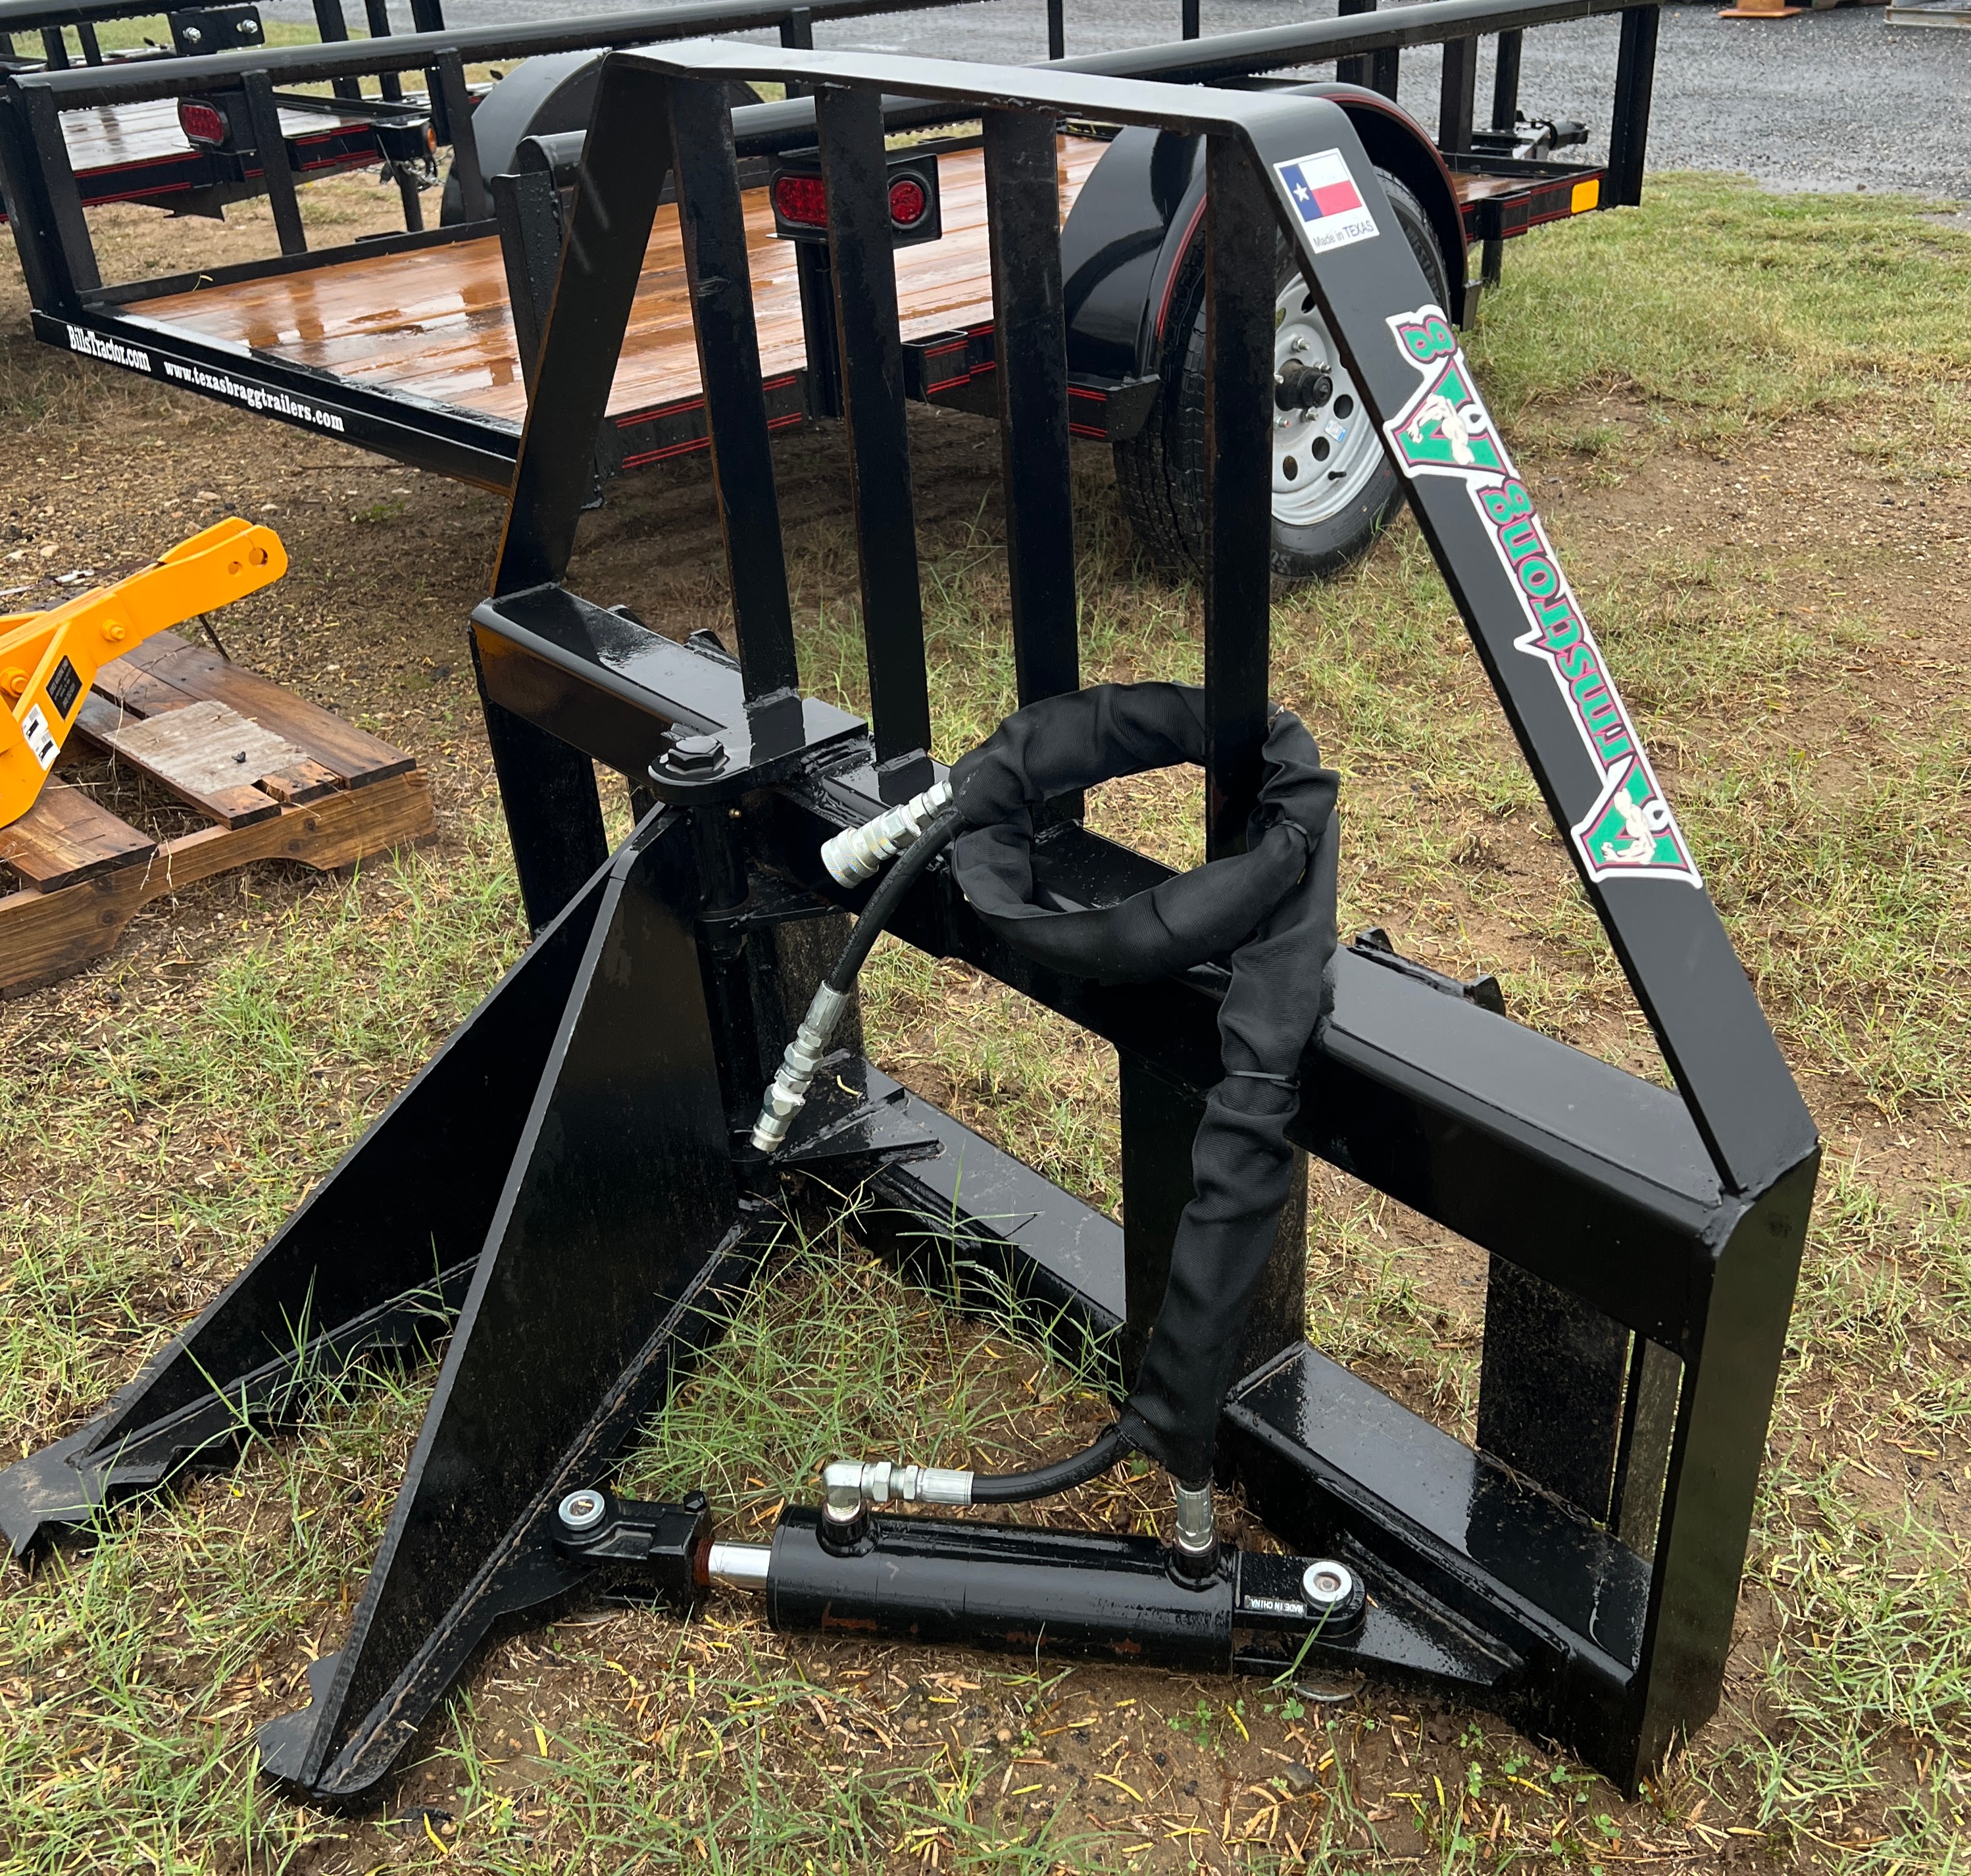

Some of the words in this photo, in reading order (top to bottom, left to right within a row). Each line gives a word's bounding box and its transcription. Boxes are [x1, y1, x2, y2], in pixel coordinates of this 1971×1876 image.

[1313, 235, 1335, 247] Made
[1335, 230, 1345, 241] in
[1343, 220, 1374, 238] TEXAS
[66, 325, 151, 372] BillsTractor.com
[164, 360, 345, 432] www.texasbraggtrailers.com
[1391, 316, 1509, 474] Ag
[1480, 478, 1689, 869] Armstrong
[1251, 1598, 1273, 1610] CHINA
[1274, 1602, 1284, 1611] IN
[1285, 1603, 1304, 1614] MADE
